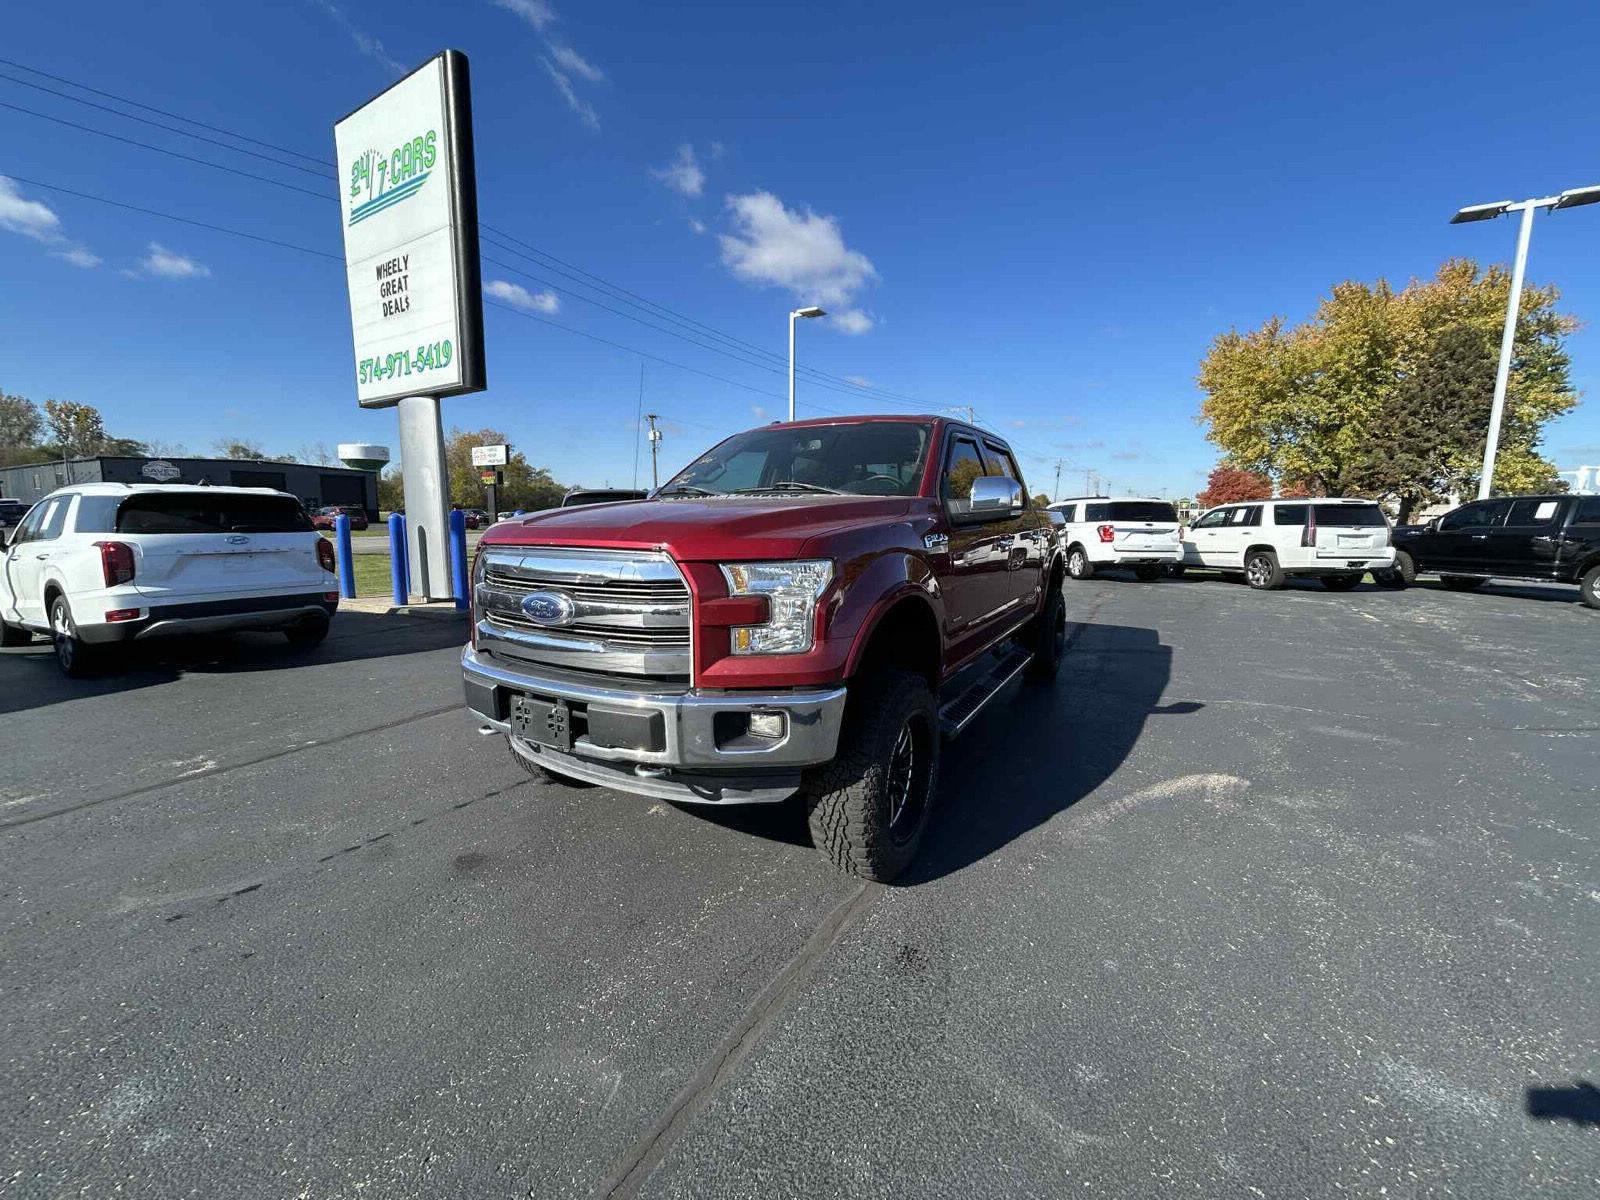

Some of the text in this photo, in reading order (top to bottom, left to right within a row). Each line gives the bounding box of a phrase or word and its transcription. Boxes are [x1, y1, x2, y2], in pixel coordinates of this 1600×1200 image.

[391, 130, 436, 185] CARS
[376, 254, 409, 281] WHEELY
[380, 275, 408, 298] GREAT
[359, 340, 452, 384] 574-971-5419
